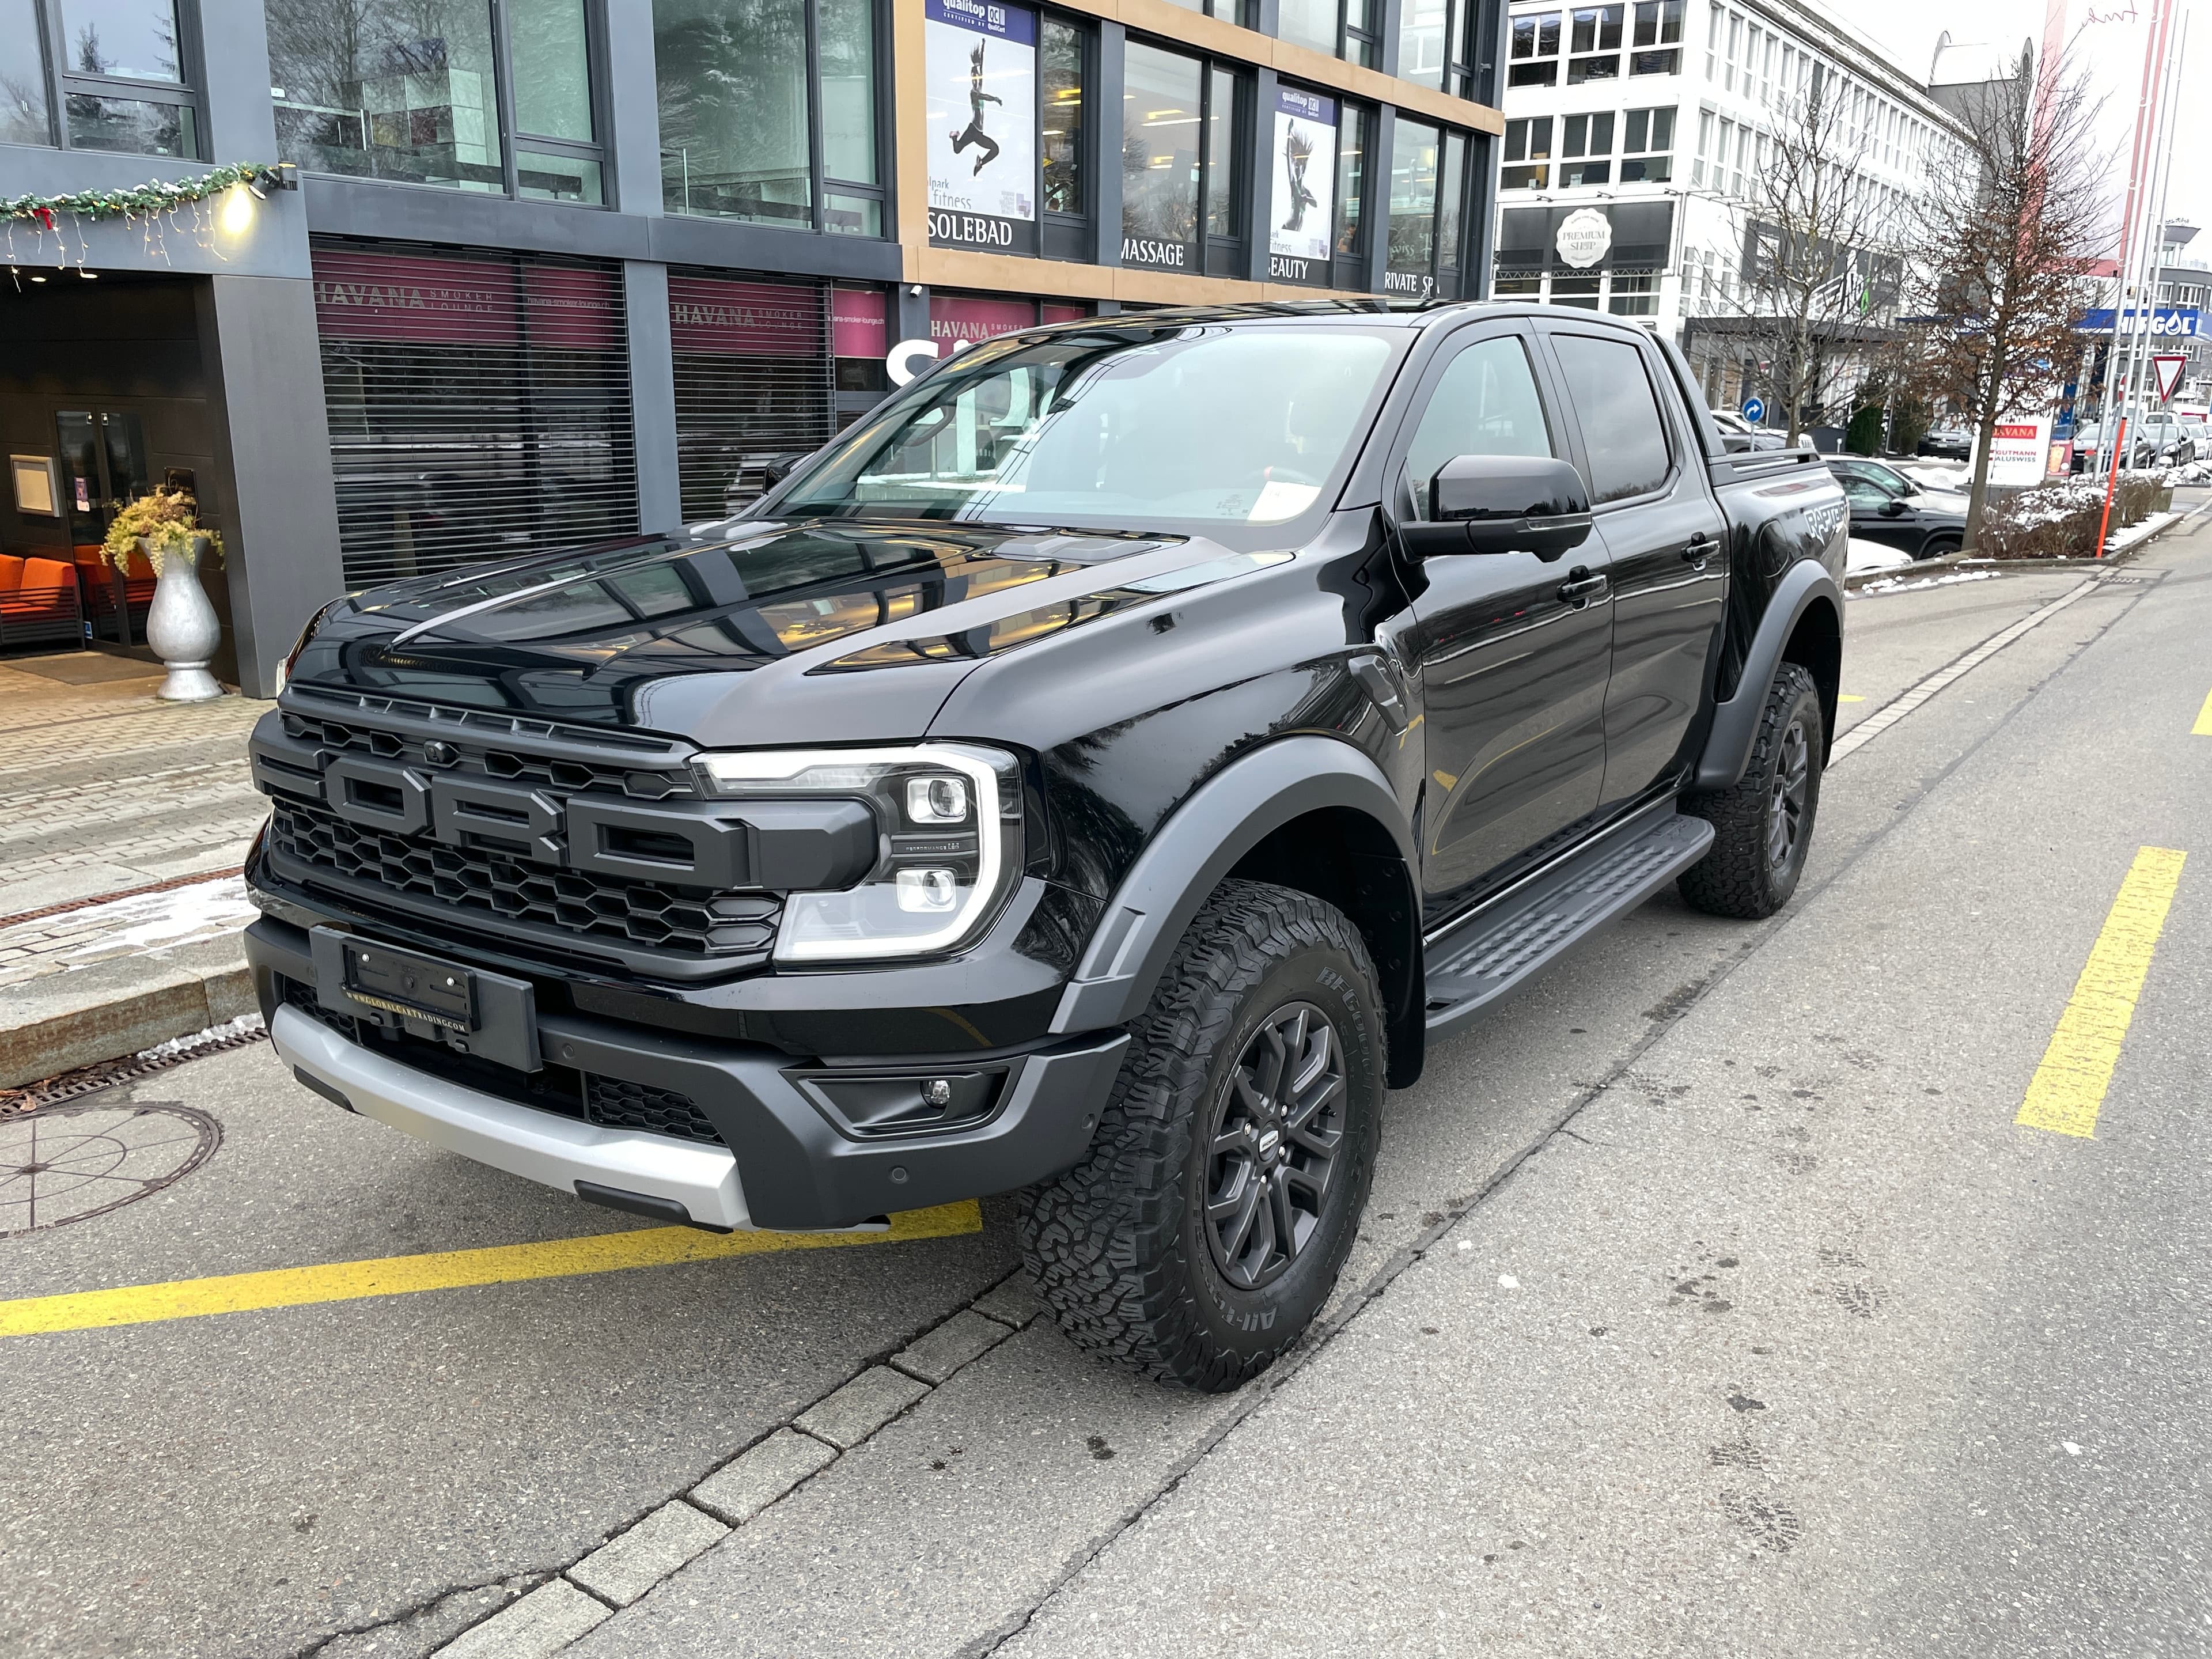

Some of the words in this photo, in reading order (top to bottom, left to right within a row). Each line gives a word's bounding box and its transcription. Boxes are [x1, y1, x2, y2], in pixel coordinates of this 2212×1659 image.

[944, 0, 986, 18] qualitop
[1282, 92, 1308, 107] qualitop
[933, 189, 972, 210] fitness
[928, 211, 1012, 246] SOLEBAD
[1563, 231, 1605, 240] PREMIUM
[1268, 257, 1309, 279] EAUTY
[1422, 275, 1440, 294] SP
[674, 305, 755, 327] HAVANA
[930, 320, 988, 339] HAVANA
[249, 732, 751, 891] FORD
